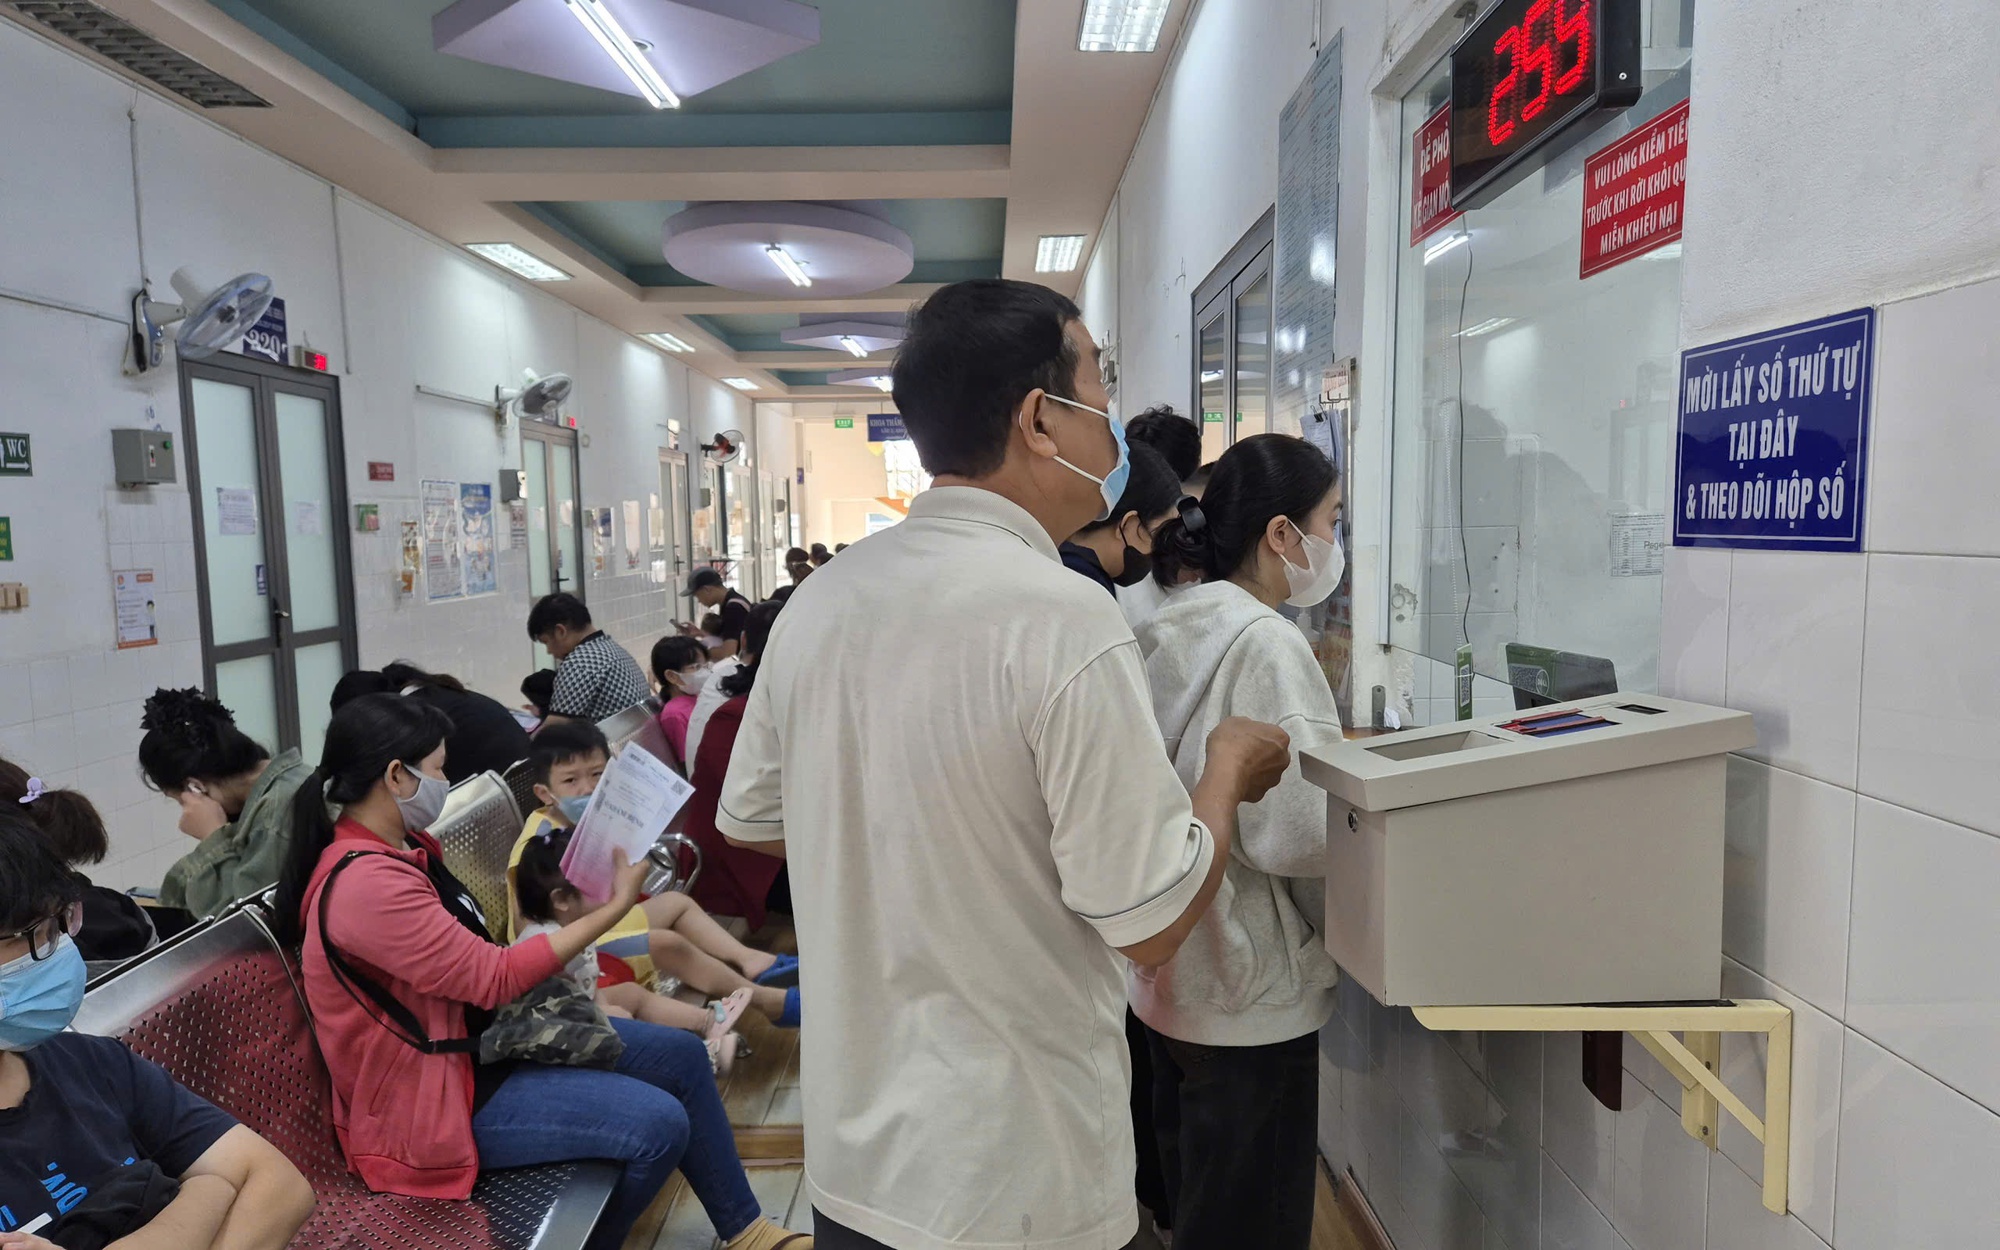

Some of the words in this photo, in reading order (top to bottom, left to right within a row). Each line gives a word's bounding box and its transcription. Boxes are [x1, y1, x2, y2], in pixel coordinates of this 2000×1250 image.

[1431, 121, 1450, 168] PHÒ
[1594, 162, 1611, 190] VUI
[1612, 148, 1638, 183] LÒNG
[1639, 128, 1665, 166] KIỂM
[1422, 187, 1438, 224] GIAN
[1438, 171, 1450, 212] MÓ
[1586, 195, 1613, 229] TRƯỚC
[1613, 187, 1629, 215] KHI
[1630, 177, 1646, 207] RỜI
[1647, 161, 1671, 199] KHỎI
[1600, 222, 1624, 256] MIỄN
[1625, 205, 1657, 244] KHIẾU
[1659, 200, 1678, 233] NẠI
[1685, 365, 1717, 414] MỜI
[1720, 353, 1755, 409] LẤY
[1757, 344, 1785, 403] SỐ
[1788, 342, 1829, 398] THỨ
[1831, 340, 1861, 400] TỰ
[6, 438, 27, 458] WC
[1728, 421, 1757, 470] TẠI
[1759, 408, 1799, 460] ĐÂY
[1685, 484, 1697, 520] &
[1700, 481, 1739, 520] THEO
[1741, 472, 1772, 520] DÕI
[1774, 469, 1814, 529] HỘP
[1817, 460, 1847, 520] SỐ
